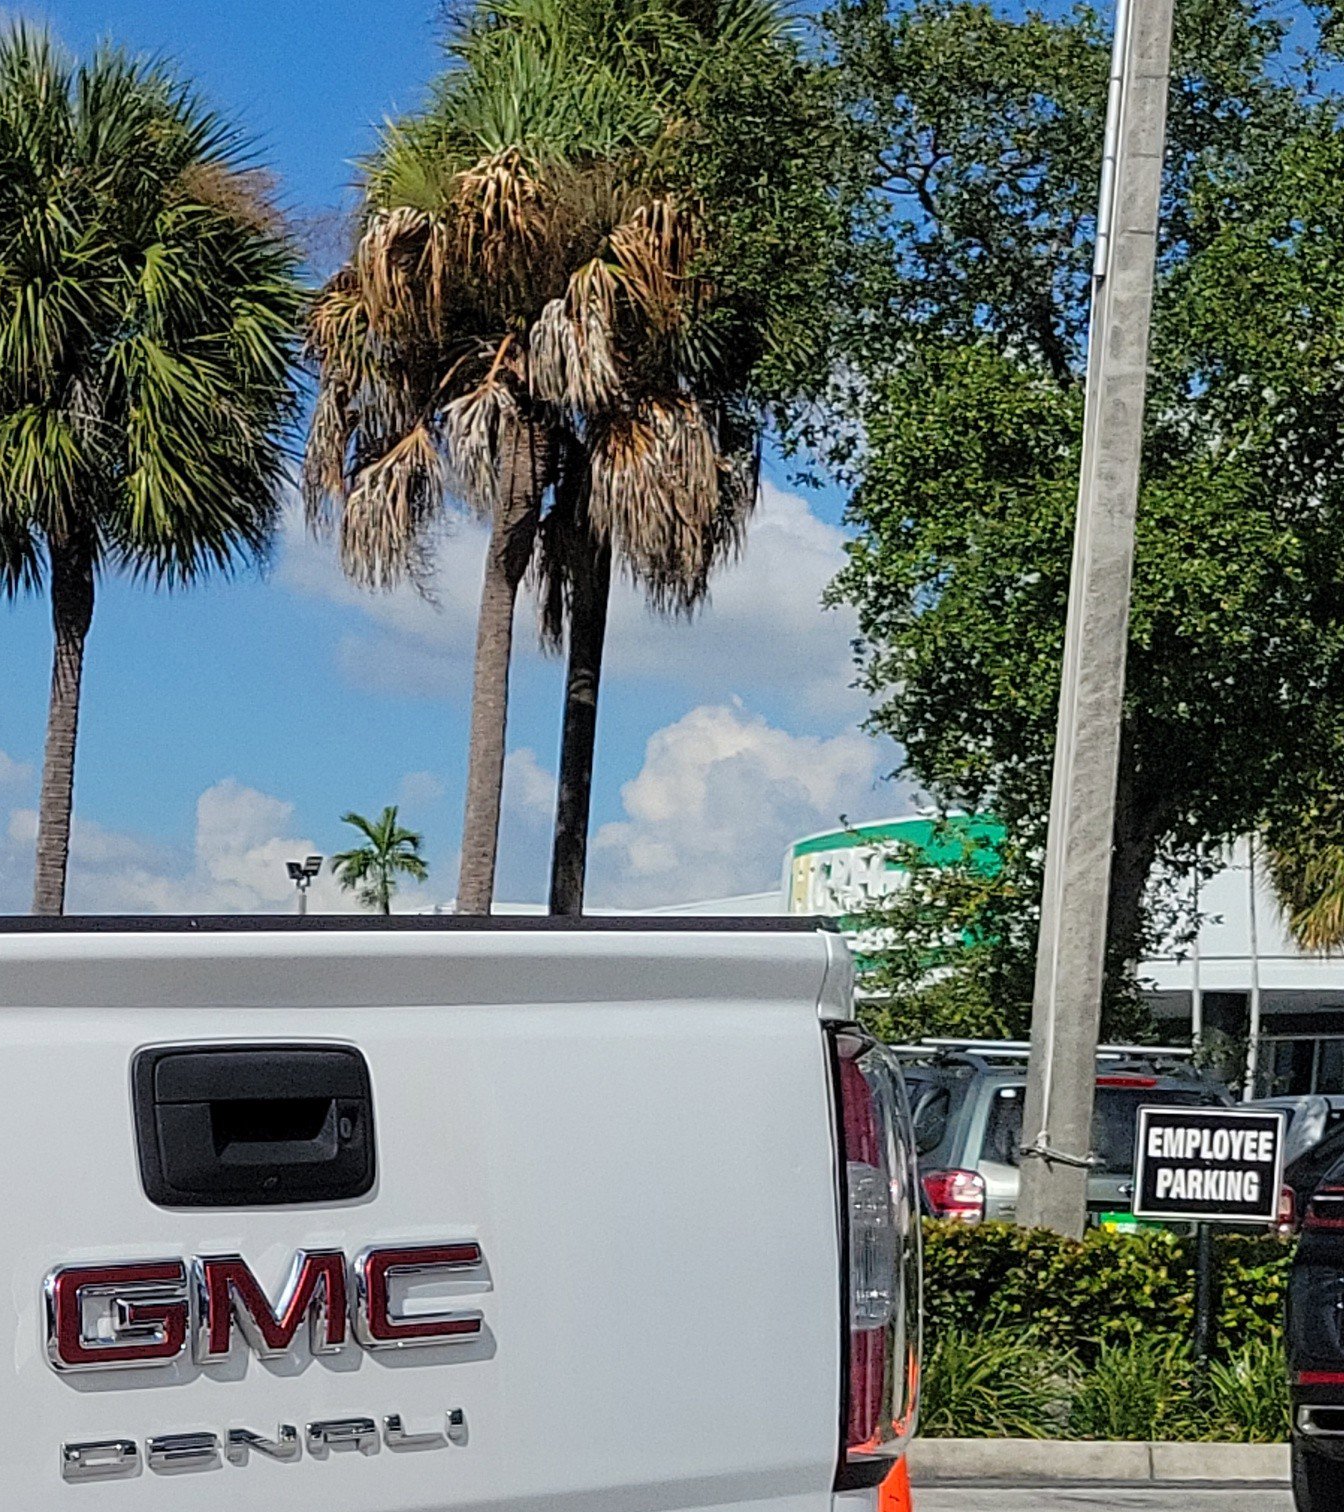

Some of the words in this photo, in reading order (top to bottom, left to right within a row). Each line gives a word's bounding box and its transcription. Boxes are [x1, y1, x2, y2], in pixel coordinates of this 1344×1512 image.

[1147, 1126, 1274, 1161] EMPLOYEE
[1155, 1168, 1259, 1202] PARKING
[43, 1240, 485, 1373] GMC
[59, 1407, 468, 1485] DENALI
